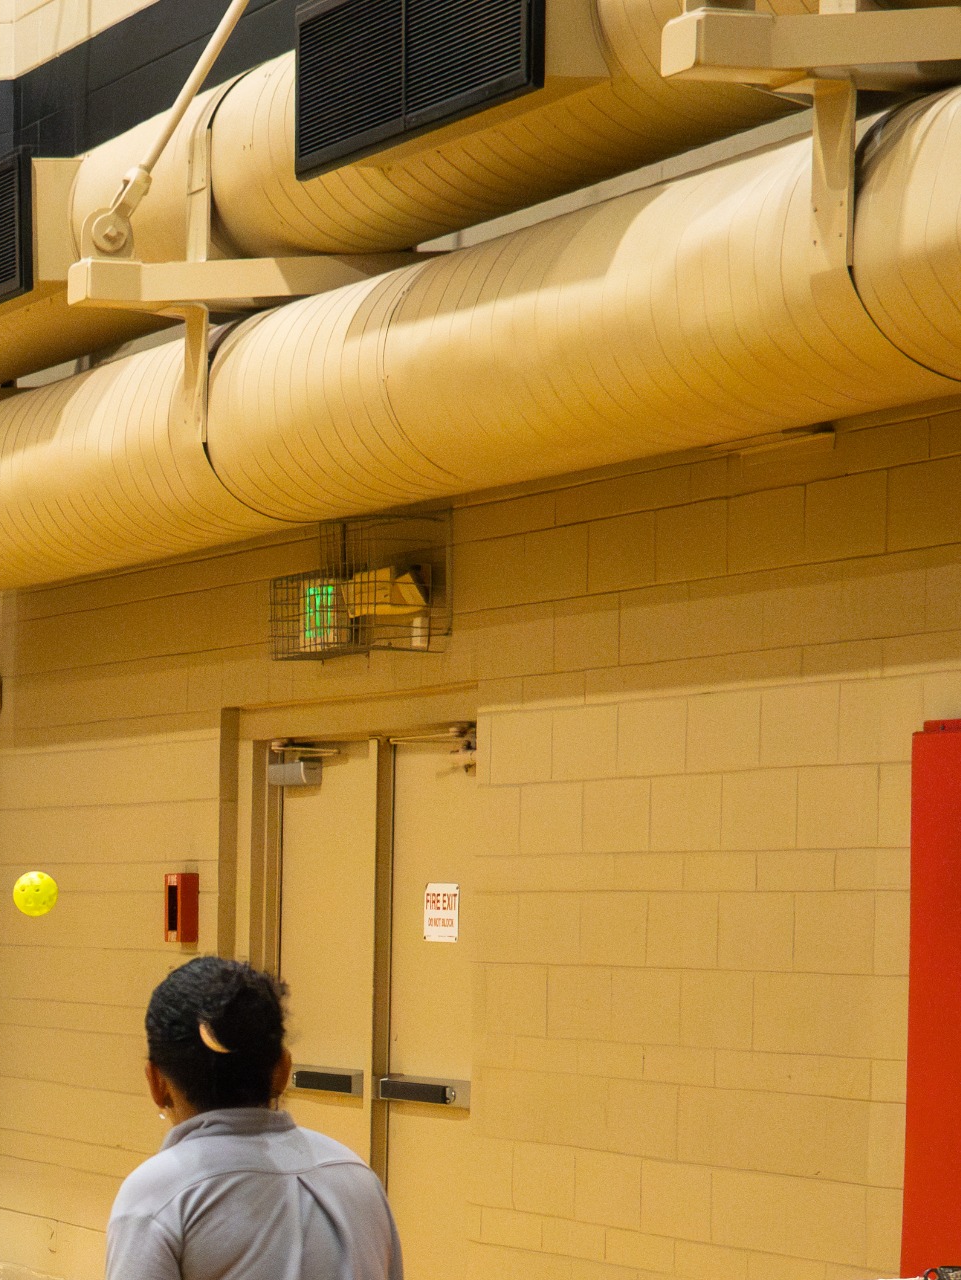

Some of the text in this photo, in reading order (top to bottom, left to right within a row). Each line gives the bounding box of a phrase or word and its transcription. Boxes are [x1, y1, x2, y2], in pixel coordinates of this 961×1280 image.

[426, 893, 457, 910] FIRE EXIT
[428, 917, 434, 927] DO
[442, 918, 454, 928] BLOCK
